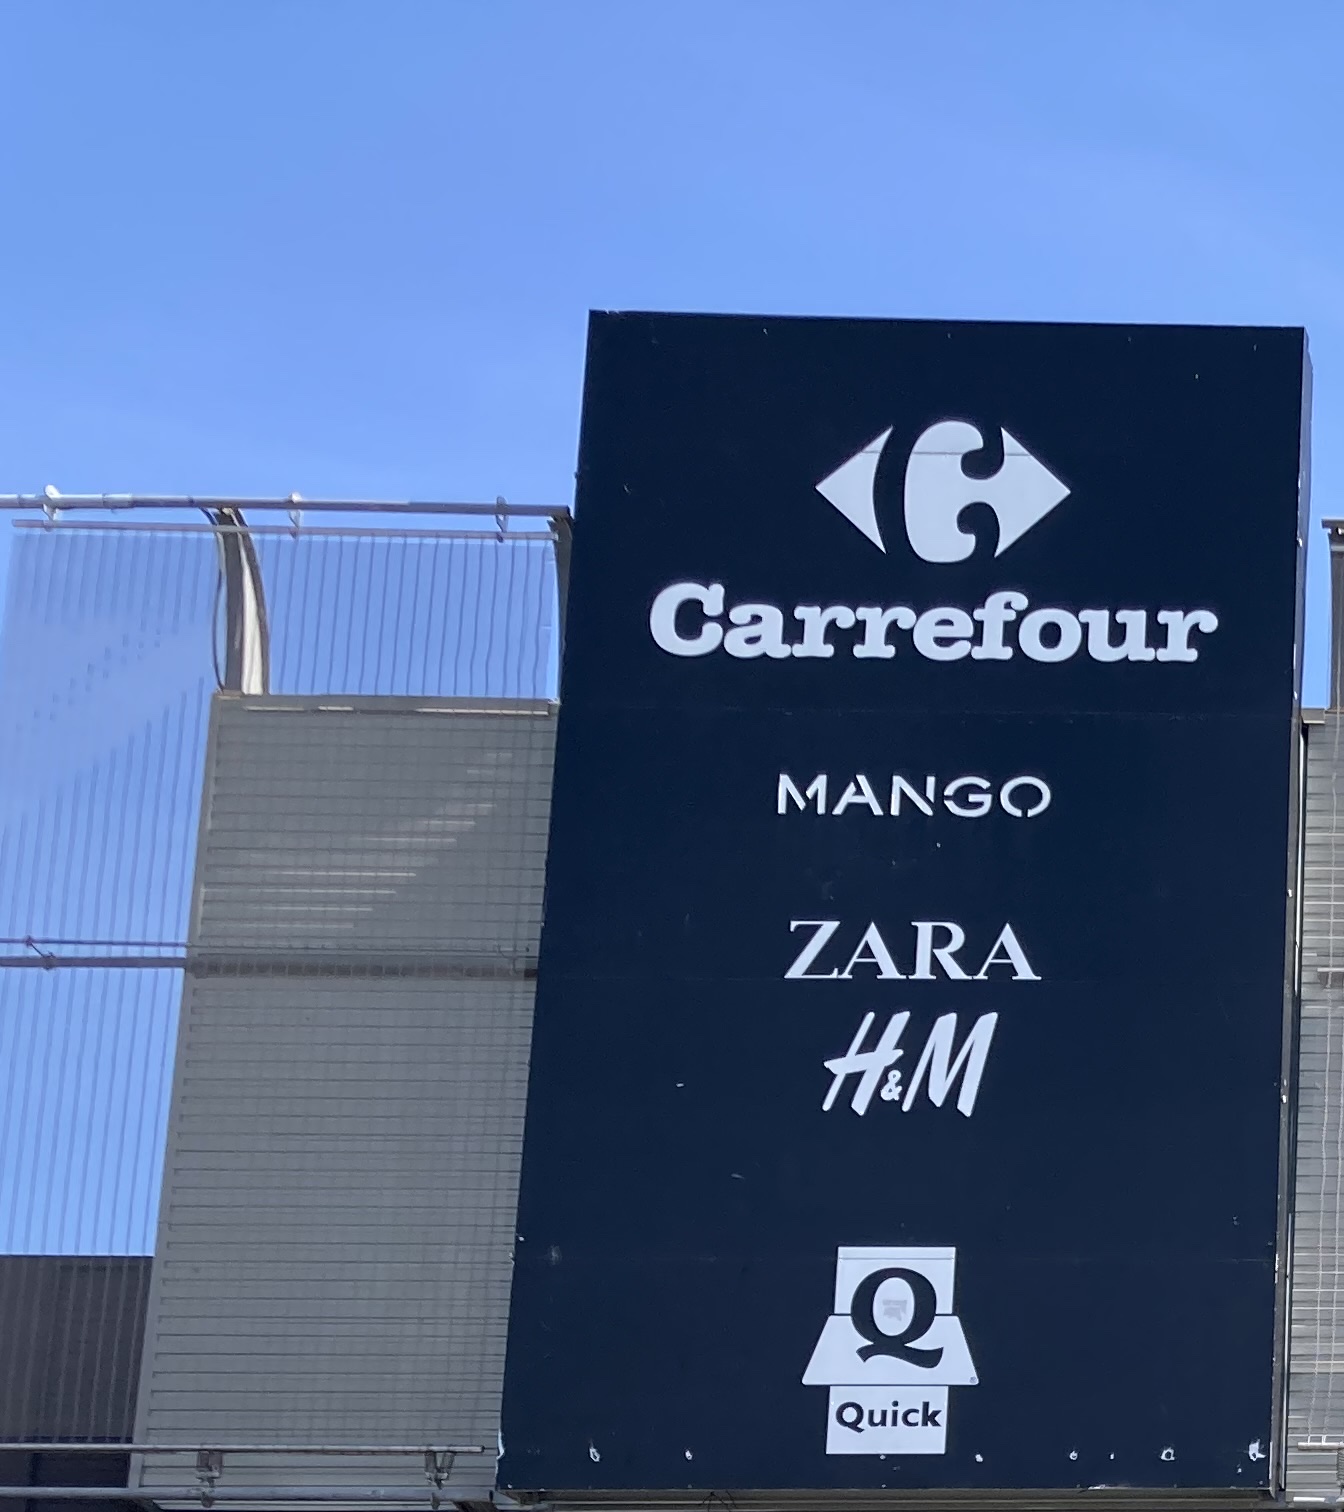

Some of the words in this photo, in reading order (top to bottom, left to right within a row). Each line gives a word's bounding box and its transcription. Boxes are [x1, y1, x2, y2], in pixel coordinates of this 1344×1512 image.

[649, 582, 1219, 663] Carrefour
[777, 772, 1052, 818] MANGO
[784, 920, 1042, 981] ZARA
[822, 1010, 998, 1117] H&M
[850, 1266, 944, 1369] Q
[835, 1400, 943, 1433] Quick
